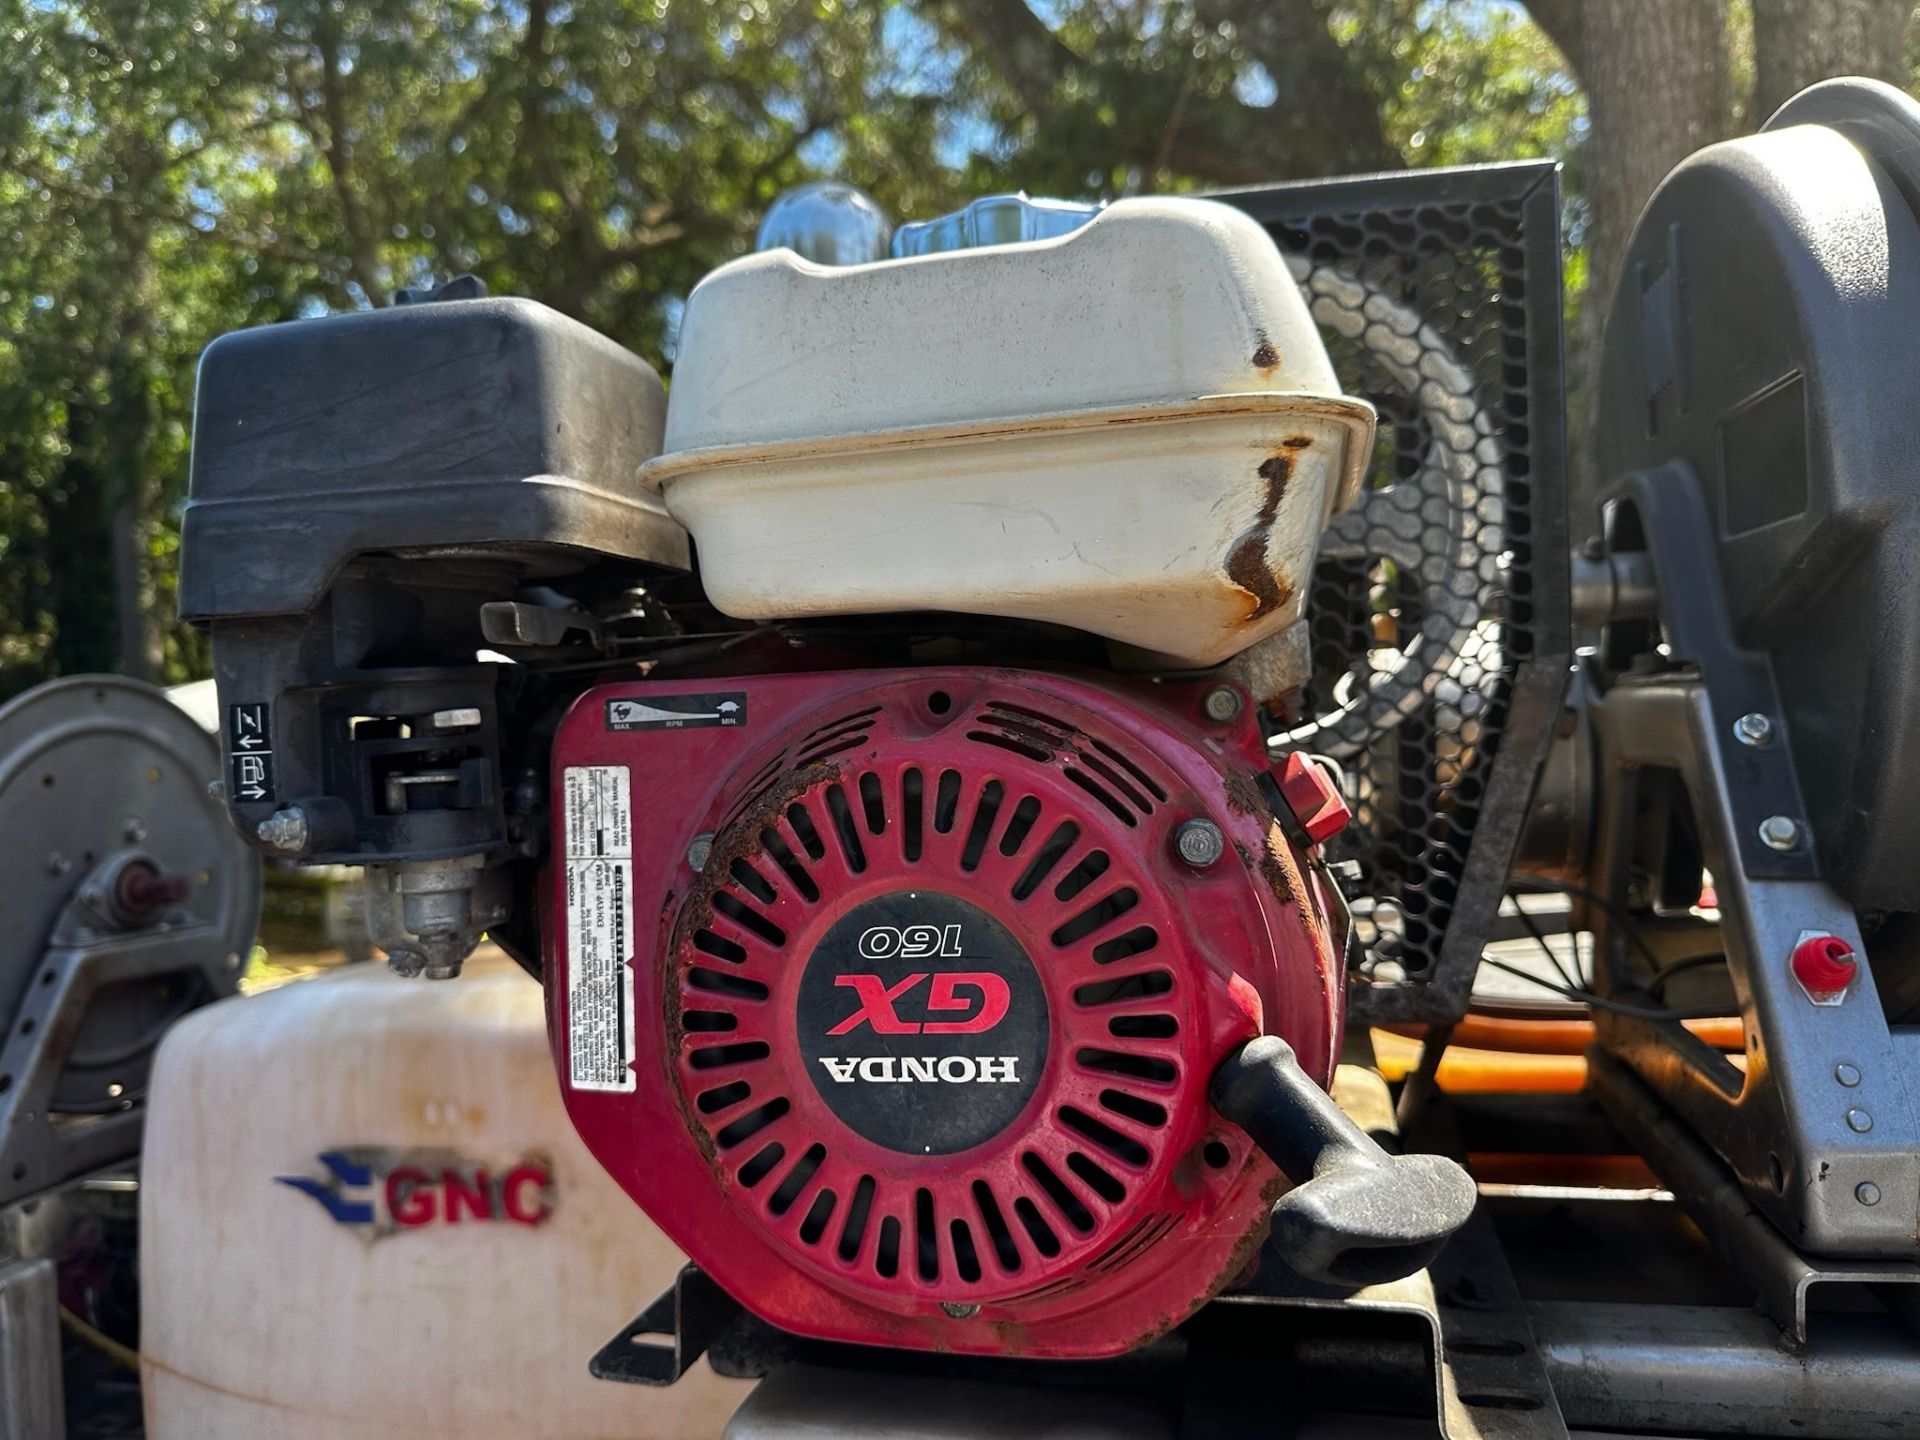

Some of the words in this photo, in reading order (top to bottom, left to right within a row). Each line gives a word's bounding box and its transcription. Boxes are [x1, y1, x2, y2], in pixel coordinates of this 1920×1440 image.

[596, 896, 604, 927] EXH/EVP
[858, 924, 962, 960] 160
[825, 972, 1011, 1036] GX
[818, 1055, 1020, 1083] HONDA
